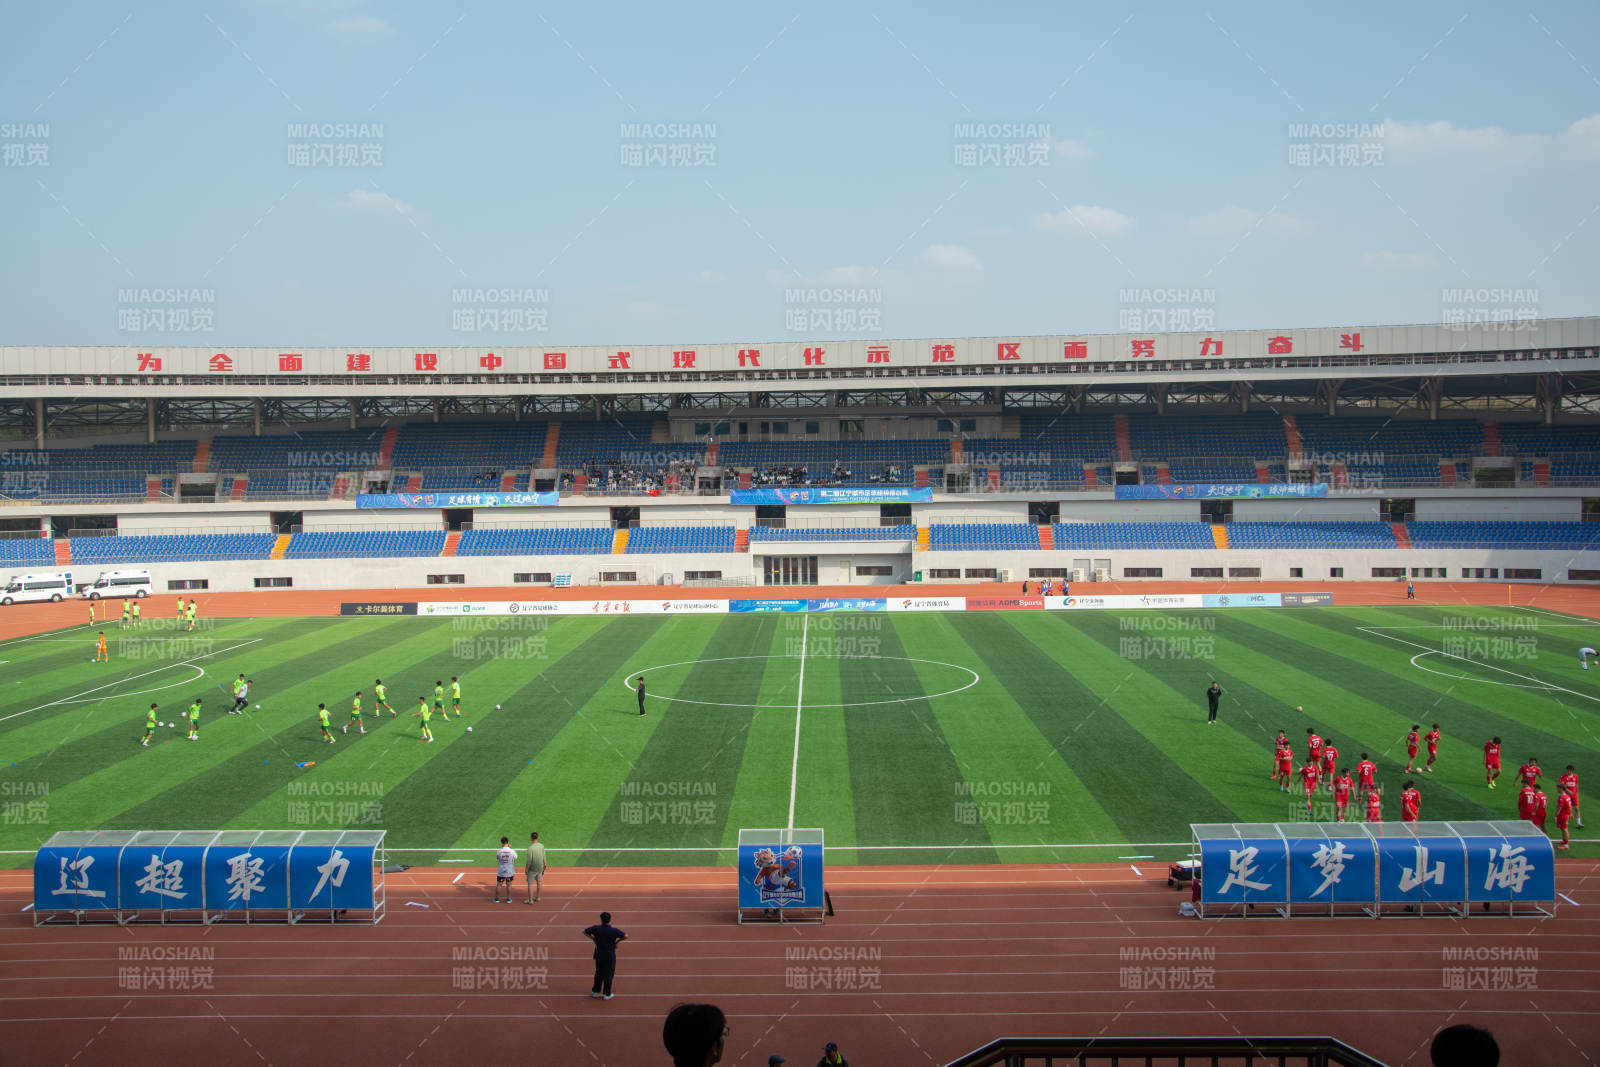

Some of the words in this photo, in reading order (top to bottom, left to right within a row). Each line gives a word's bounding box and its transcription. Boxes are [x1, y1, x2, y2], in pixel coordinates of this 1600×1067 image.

[137, 333, 1364, 372] 为全面建设中国式现代化示范区而努力奋斗
[52, 849, 350, 904] 辽超聚力
[1217, 841, 1536, 899] 足梦山海
